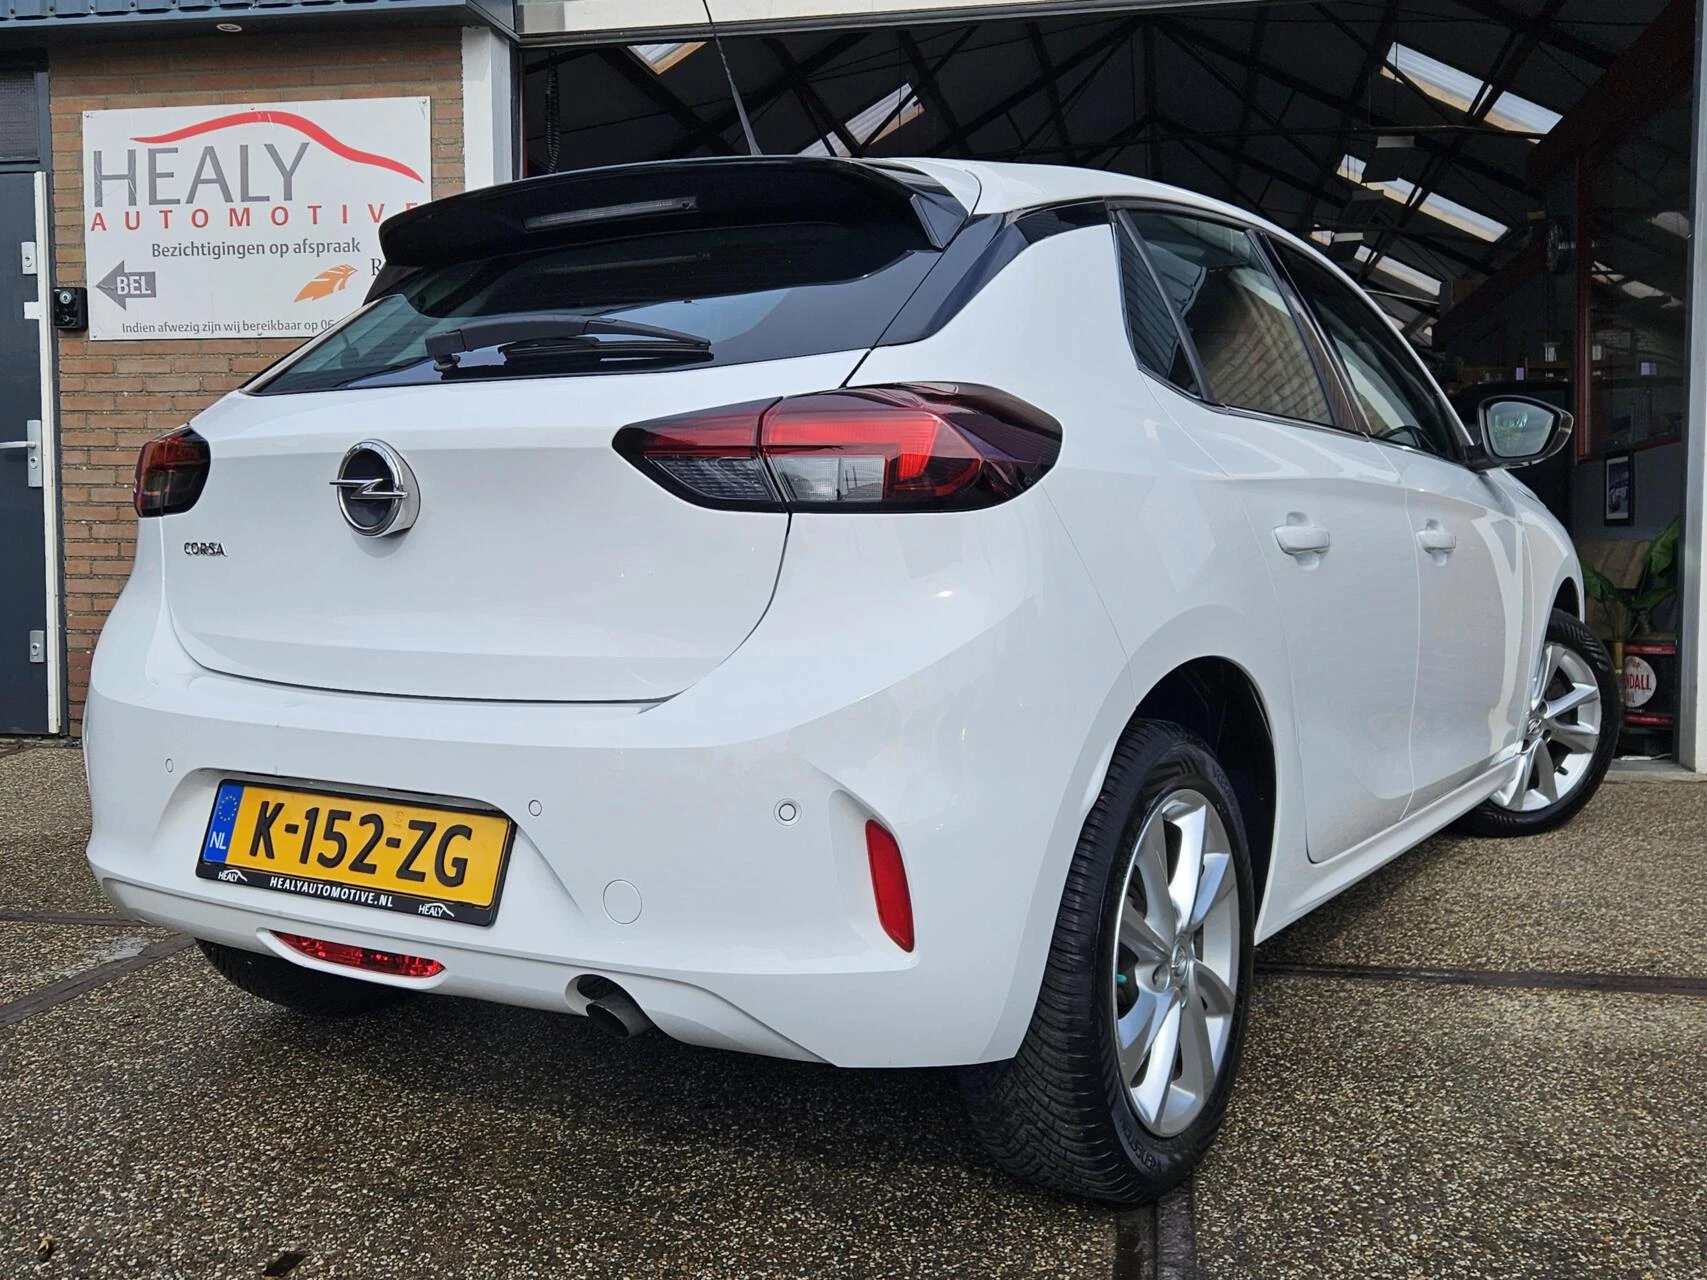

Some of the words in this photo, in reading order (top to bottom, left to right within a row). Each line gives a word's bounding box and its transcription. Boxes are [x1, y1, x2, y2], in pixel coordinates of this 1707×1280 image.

[93, 142, 310, 207] HEALY
[151, 241, 266, 260] Bezichtigingen
[269, 244, 290, 259] op
[293, 237, 361, 257] afspraak
[116, 276, 151, 295] BEL
[122, 322, 156, 333] Indien
[158, 321, 200, 334] afwezig
[202, 321, 221, 334] zijn
[224, 321, 241, 333] wij
[242, 319, 300, 332] bereikbaar
[303, 321, 318, 332] op
[184, 542, 226, 557] CORSA
[209, 831, 227, 850] NL
[249, 800, 473, 888] K-152-ZG
[218, 871, 240, 882] HEALY
[270, 876, 393, 907] HEALYAUTOMOTIVE.NL
[418, 904, 444, 918] HEALY
